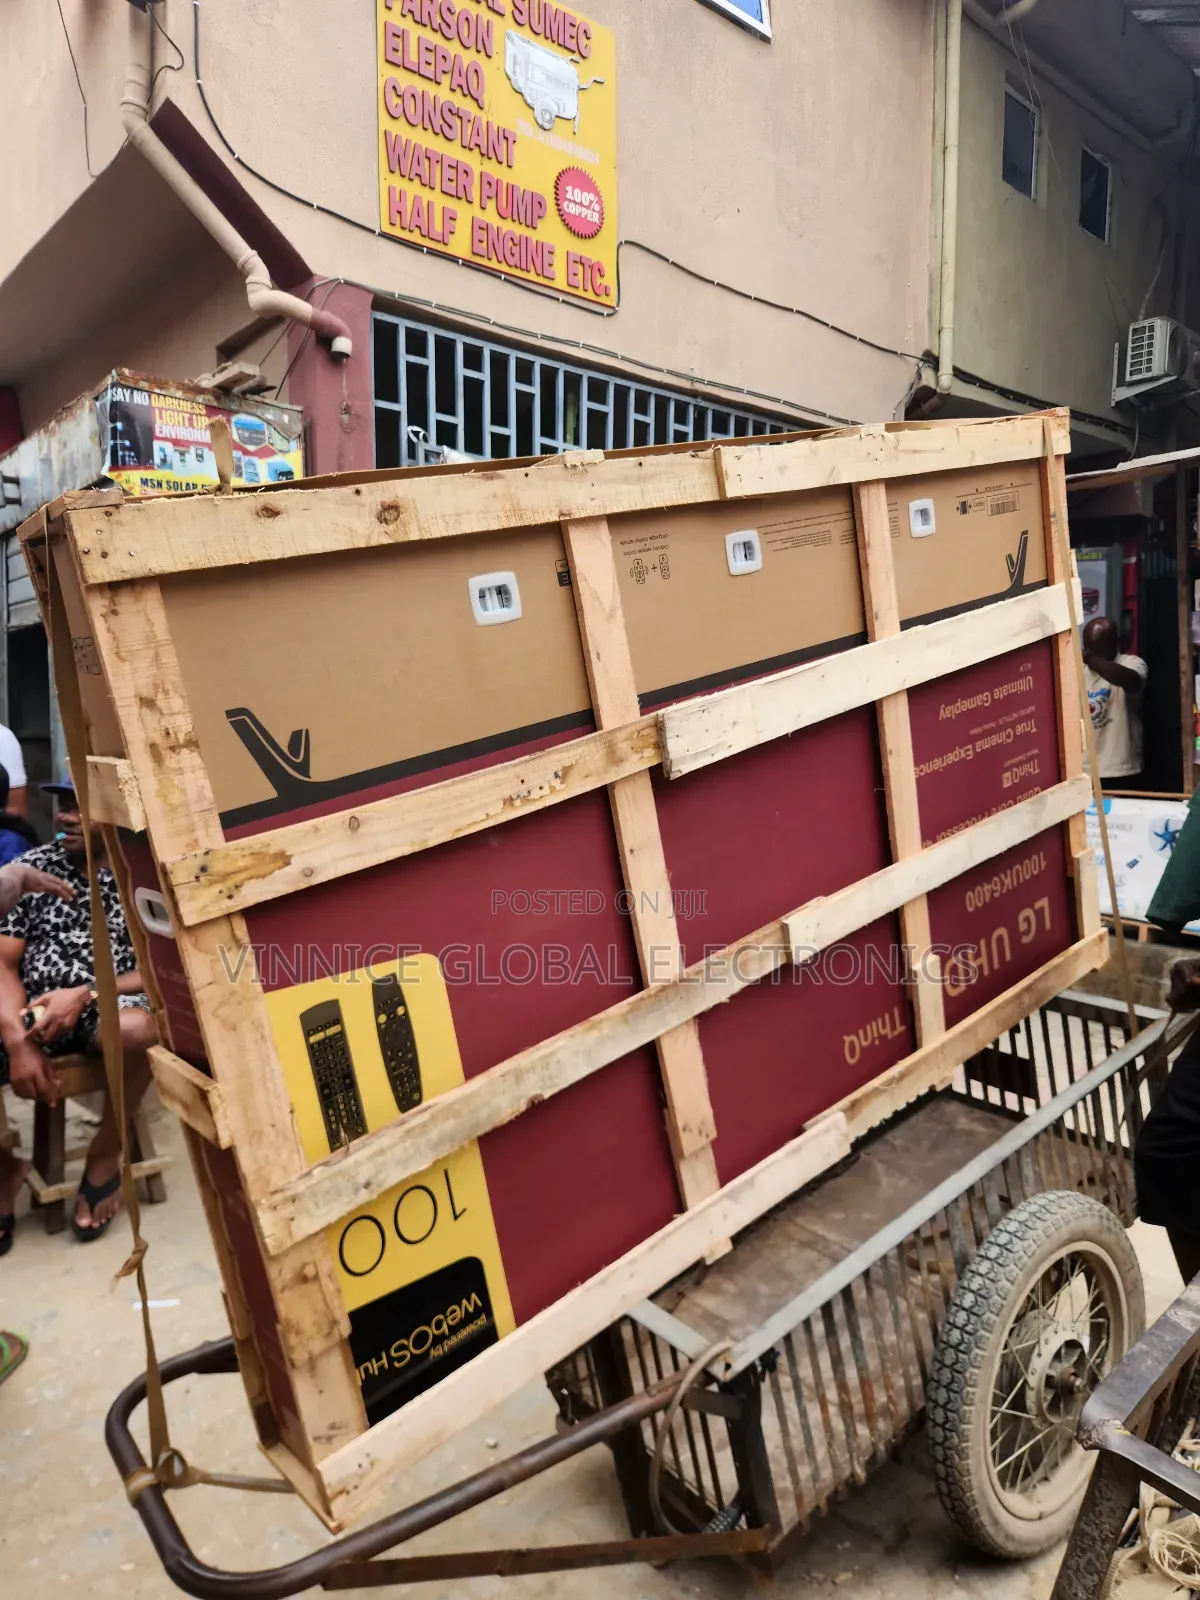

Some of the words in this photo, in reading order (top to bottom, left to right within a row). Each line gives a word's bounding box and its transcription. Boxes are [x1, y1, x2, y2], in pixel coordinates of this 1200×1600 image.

[385, 0, 494, 58] ARSON
[512, 0, 592, 58] SUMEC
[384, 20, 485, 109] ELEPAQ
[384, 77, 517, 168] CONSTANT
[384, 129, 475, 203] WATER
[479, 170, 547, 229] PUMP
[563, 200, 600, 223] COPPER
[565, 185, 600, 211] 100%
[388, 184, 458, 245] HALF
[471, 216, 556, 280] ENGINE
[566, 249, 611, 297] ETC.
[113, 387, 131, 403] SAY
[133, 390, 149, 406] NO
[151, 393, 207, 415] DARKNESS
[154, 408, 191, 427] LIGHT
[193, 412, 209, 431] UP
[155, 423, 211, 443] ENVIRONM
[140, 477, 162, 489] MSN
[166, 480, 198, 491] SOLAR
[993, 675, 1033, 700] Ultimate
[939, 692, 991, 721] Gameplay
[975, 729, 1014, 752] Cinema
[1015, 719, 1037, 736] True
[914, 745, 974, 778] Experience
[1013, 759, 1040, 783] ThinQ
[965, 851, 1047, 912] 100UK6400
[1018, 897, 1051, 944] LG
[943, 926, 1012, 997] UHD
[843, 1006, 906, 1065] ThinQ
[338, 1169, 467, 1277] 100
[389, 1292, 483, 1369] webOS
[444, 1312, 487, 1351] powered
[429, 1345, 443, 1360] by
